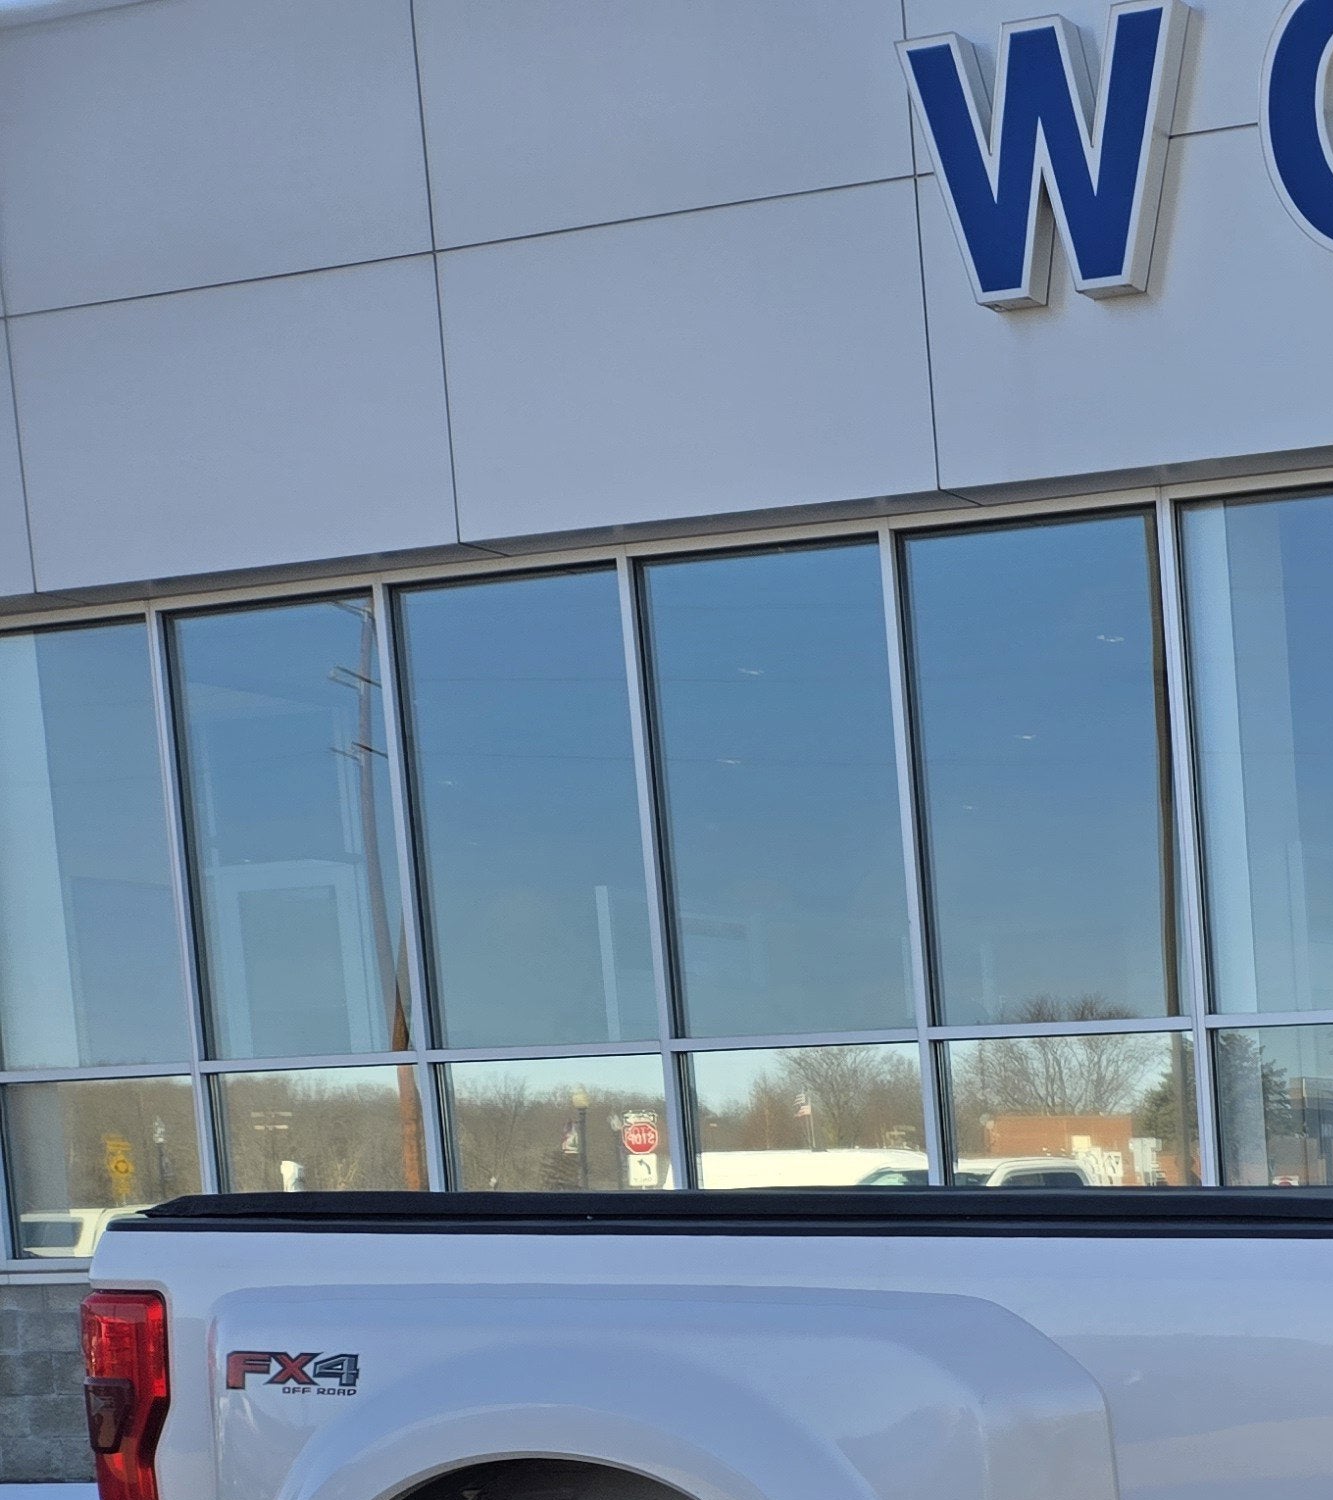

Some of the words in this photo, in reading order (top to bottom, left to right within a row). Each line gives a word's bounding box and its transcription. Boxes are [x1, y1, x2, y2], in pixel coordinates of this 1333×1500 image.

[225, 1350, 360, 1390] FX4
[281, 1386, 312, 1395] OFF
[316, 1387, 357, 1397] ROAD
